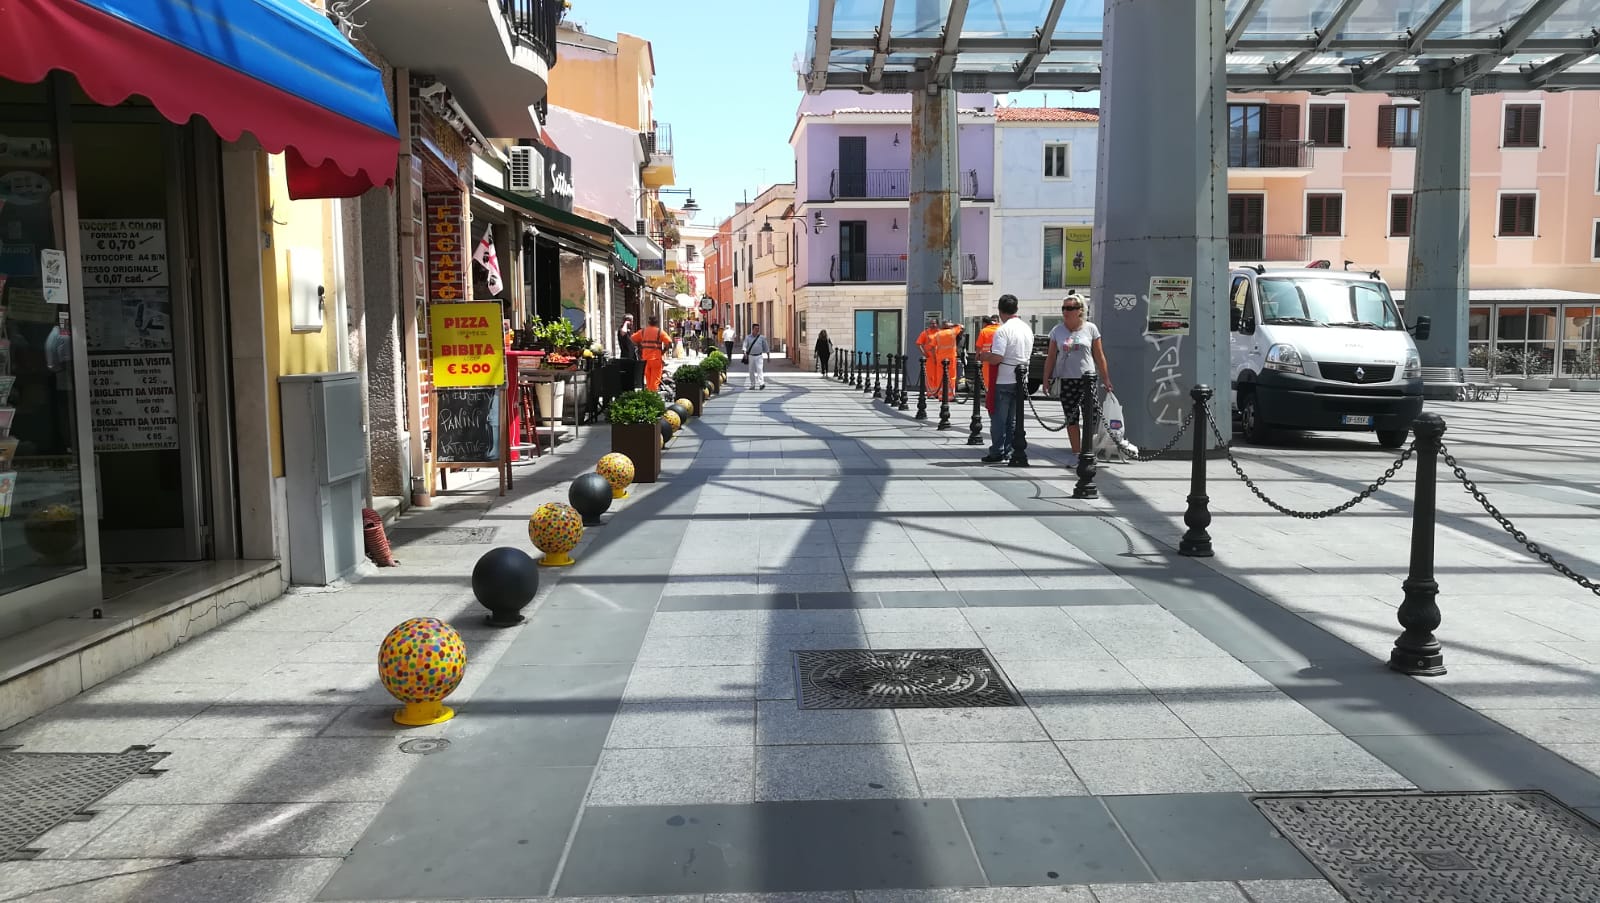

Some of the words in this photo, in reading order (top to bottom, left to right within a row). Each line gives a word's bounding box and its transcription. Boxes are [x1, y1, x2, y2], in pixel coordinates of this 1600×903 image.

[128, 222, 161, 231] COLORI
[109, 240, 136, 251] 0,70
[112, 265, 159, 273] ORIGINALE
[444, 316, 489, 329] PIZZA
[441, 343, 495, 356] BIBITA
[91, 358, 131, 367] BIGLIETTI
[133, 358, 144, 366] DA
[145, 357, 171, 366] VISITA
[447, 363, 457, 374] €
[94, 388, 133, 397] BIGLIETTI
[135, 388, 146, 396] DA
[148, 387, 174, 395] VISITA
[96, 418, 136, 427] BIGLIETTI
[150, 417, 177, 425] VISITA
[440, 408, 482, 432] PANINI
